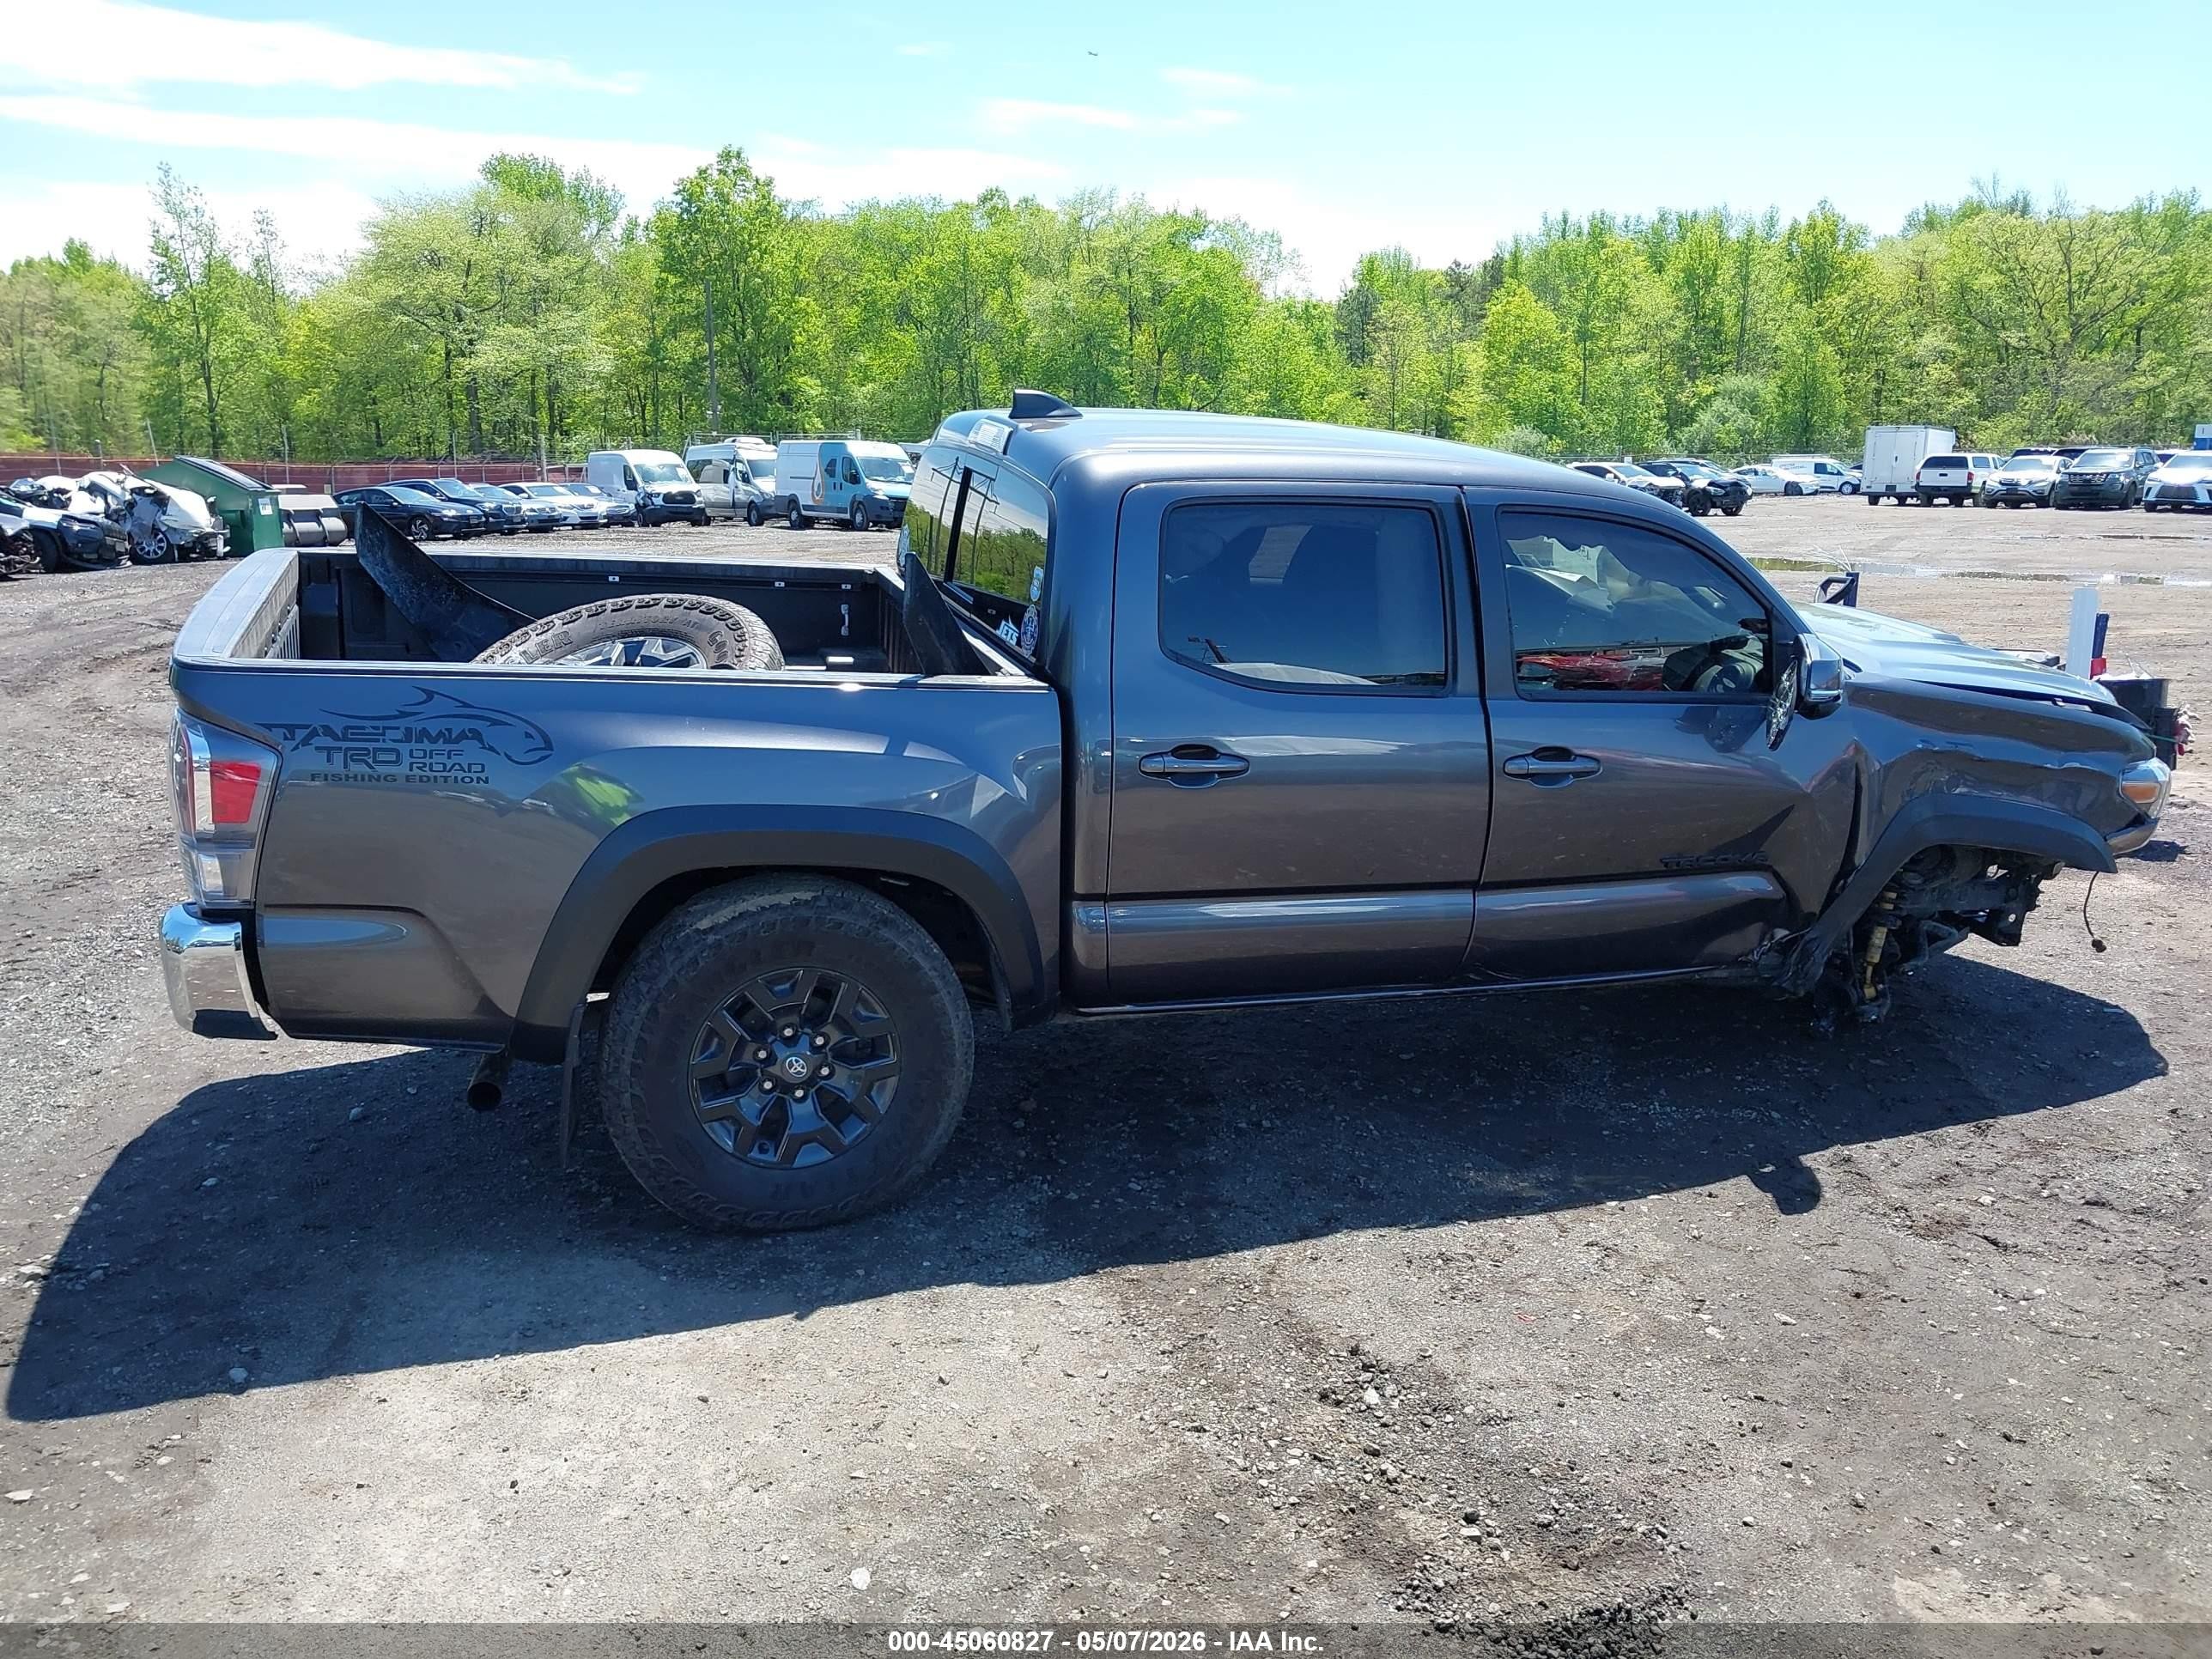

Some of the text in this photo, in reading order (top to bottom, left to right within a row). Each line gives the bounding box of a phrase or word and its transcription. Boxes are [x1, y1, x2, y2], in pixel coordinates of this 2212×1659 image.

[996, 619, 1018, 646] JETS
[254, 722, 501, 756] TACOMA
[314, 745, 404, 772] TRD
[409, 748, 465, 760] OFF
[409, 762, 486, 773] ROAD
[310, 773, 490, 785] FISHING EDITION
